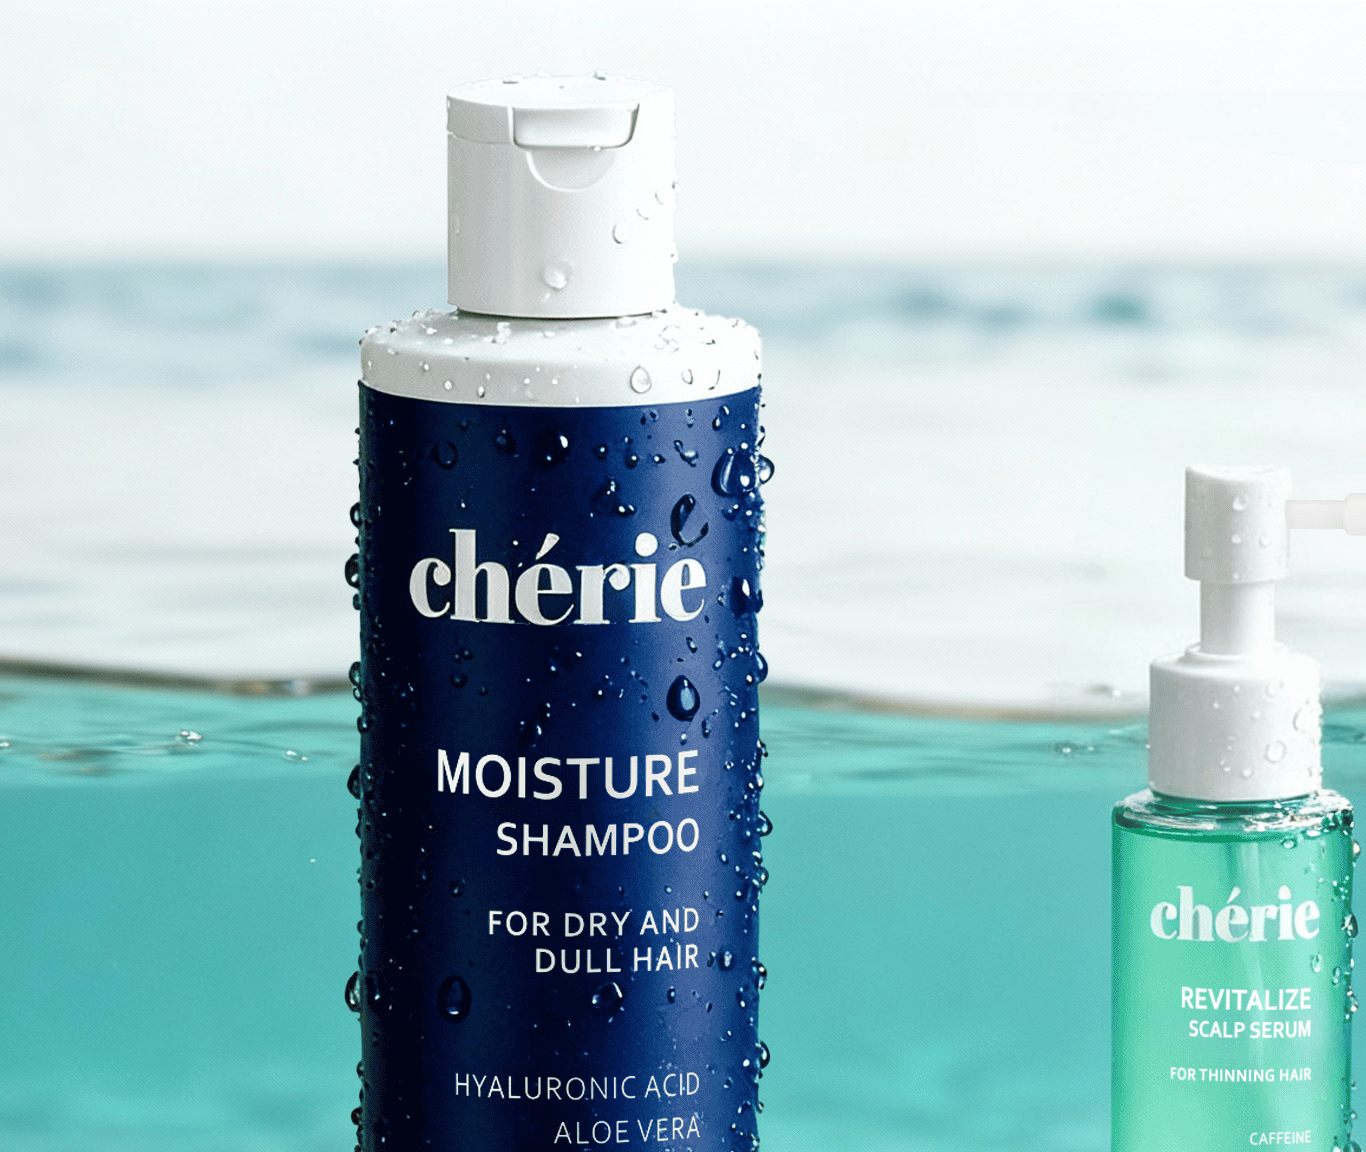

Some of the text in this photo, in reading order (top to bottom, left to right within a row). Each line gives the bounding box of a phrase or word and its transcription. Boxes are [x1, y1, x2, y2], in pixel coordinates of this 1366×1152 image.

[409, 529, 707, 625] chérie
[437, 749, 700, 800] MOISTURE
[496, 818, 700, 857] SHAMPOO
[488, 907, 700, 937] FOR DRY AND
[1150, 885, 1320, 942] chérie
[536, 944, 700, 973] DULL HAIR
[1181, 986, 1312, 1011] REVITALIZE
[1189, 1020, 1312, 1039] SCALP SERUM
[455, 1072, 700, 1100] HYALURONIC ACID
[1170, 1067, 1312, 1083] FOR THINNING HAIR
[554, 1116, 700, 1145] ALOE VERA
[1250, 1130, 1312, 1146] CAFFEINE
